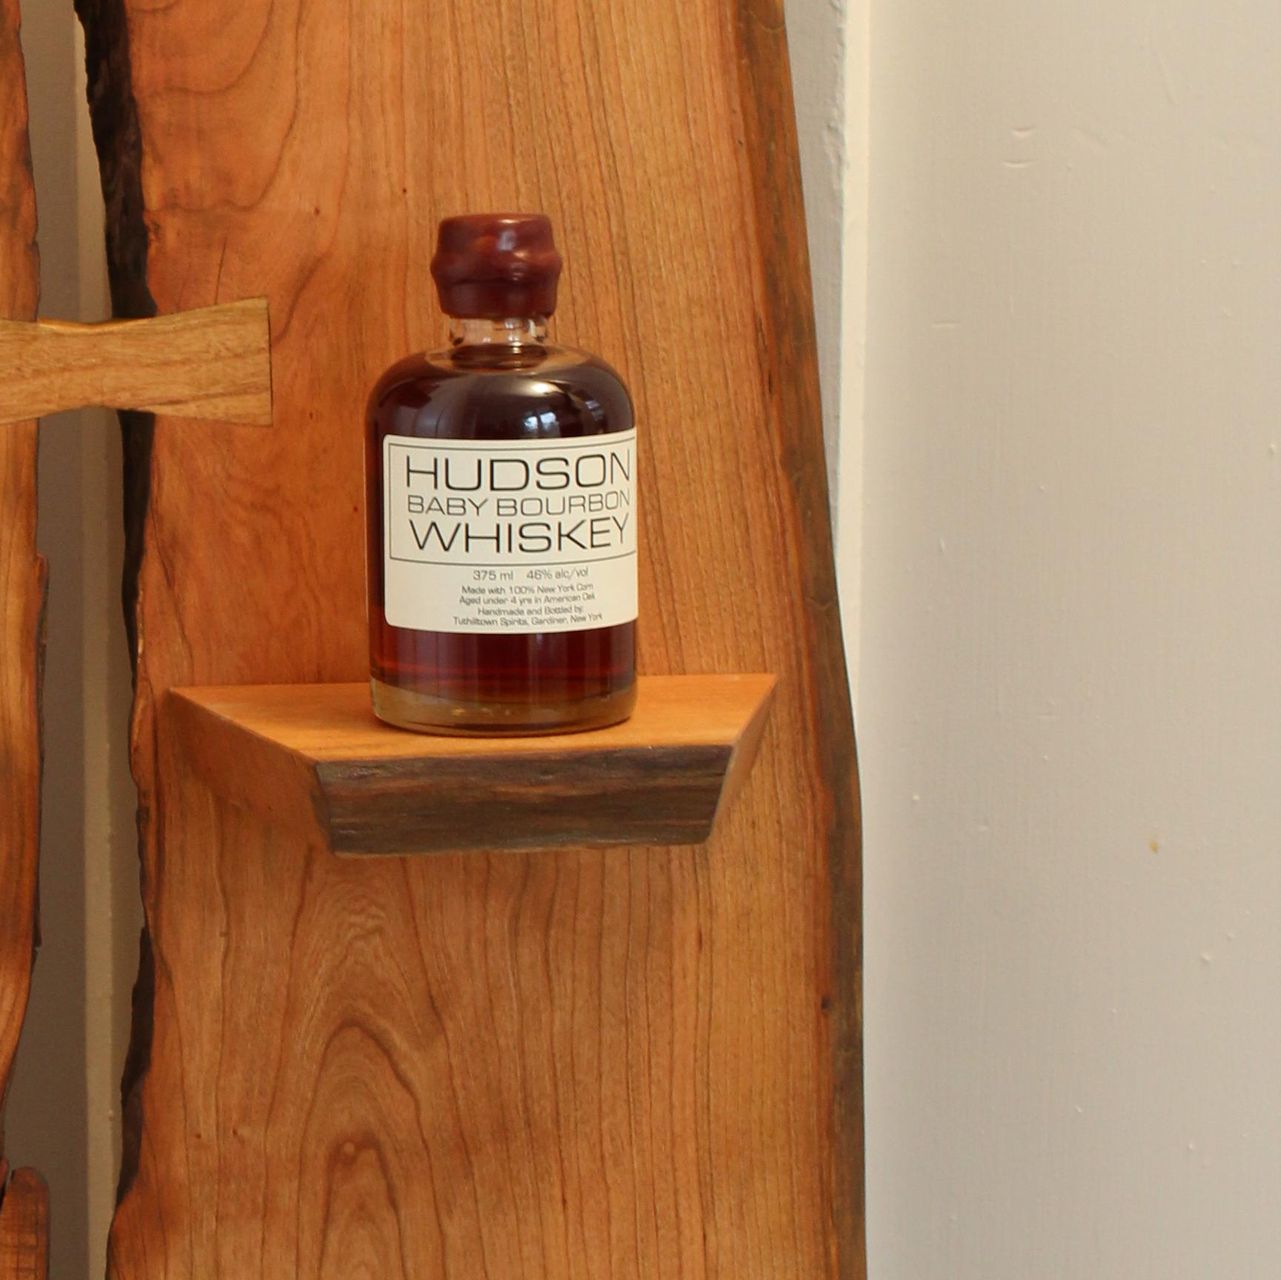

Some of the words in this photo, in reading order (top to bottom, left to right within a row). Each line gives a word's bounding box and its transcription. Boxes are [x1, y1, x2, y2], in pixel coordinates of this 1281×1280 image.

[406, 448, 630, 492] HUDSON
[407, 494, 489, 517] BABY
[497, 488, 630, 517] BOURBON
[408, 512, 629, 554] WHISKEY
[473, 570, 496, 581] 375
[500, 570, 514, 581] ml
[526, 569, 553, 580] 46%
[555, 567, 589, 580] alc/vol
[461, 586, 486, 595] Made
[488, 586, 506, 595] with
[537, 584, 557, 593] New
[557, 584, 575, 593] York
[459, 596, 481, 606] Aged
[483, 596, 509, 605] under
[544, 594, 582, 603] American
[478, 607, 525, 616] Handmade
[526, 606, 543, 615] and
